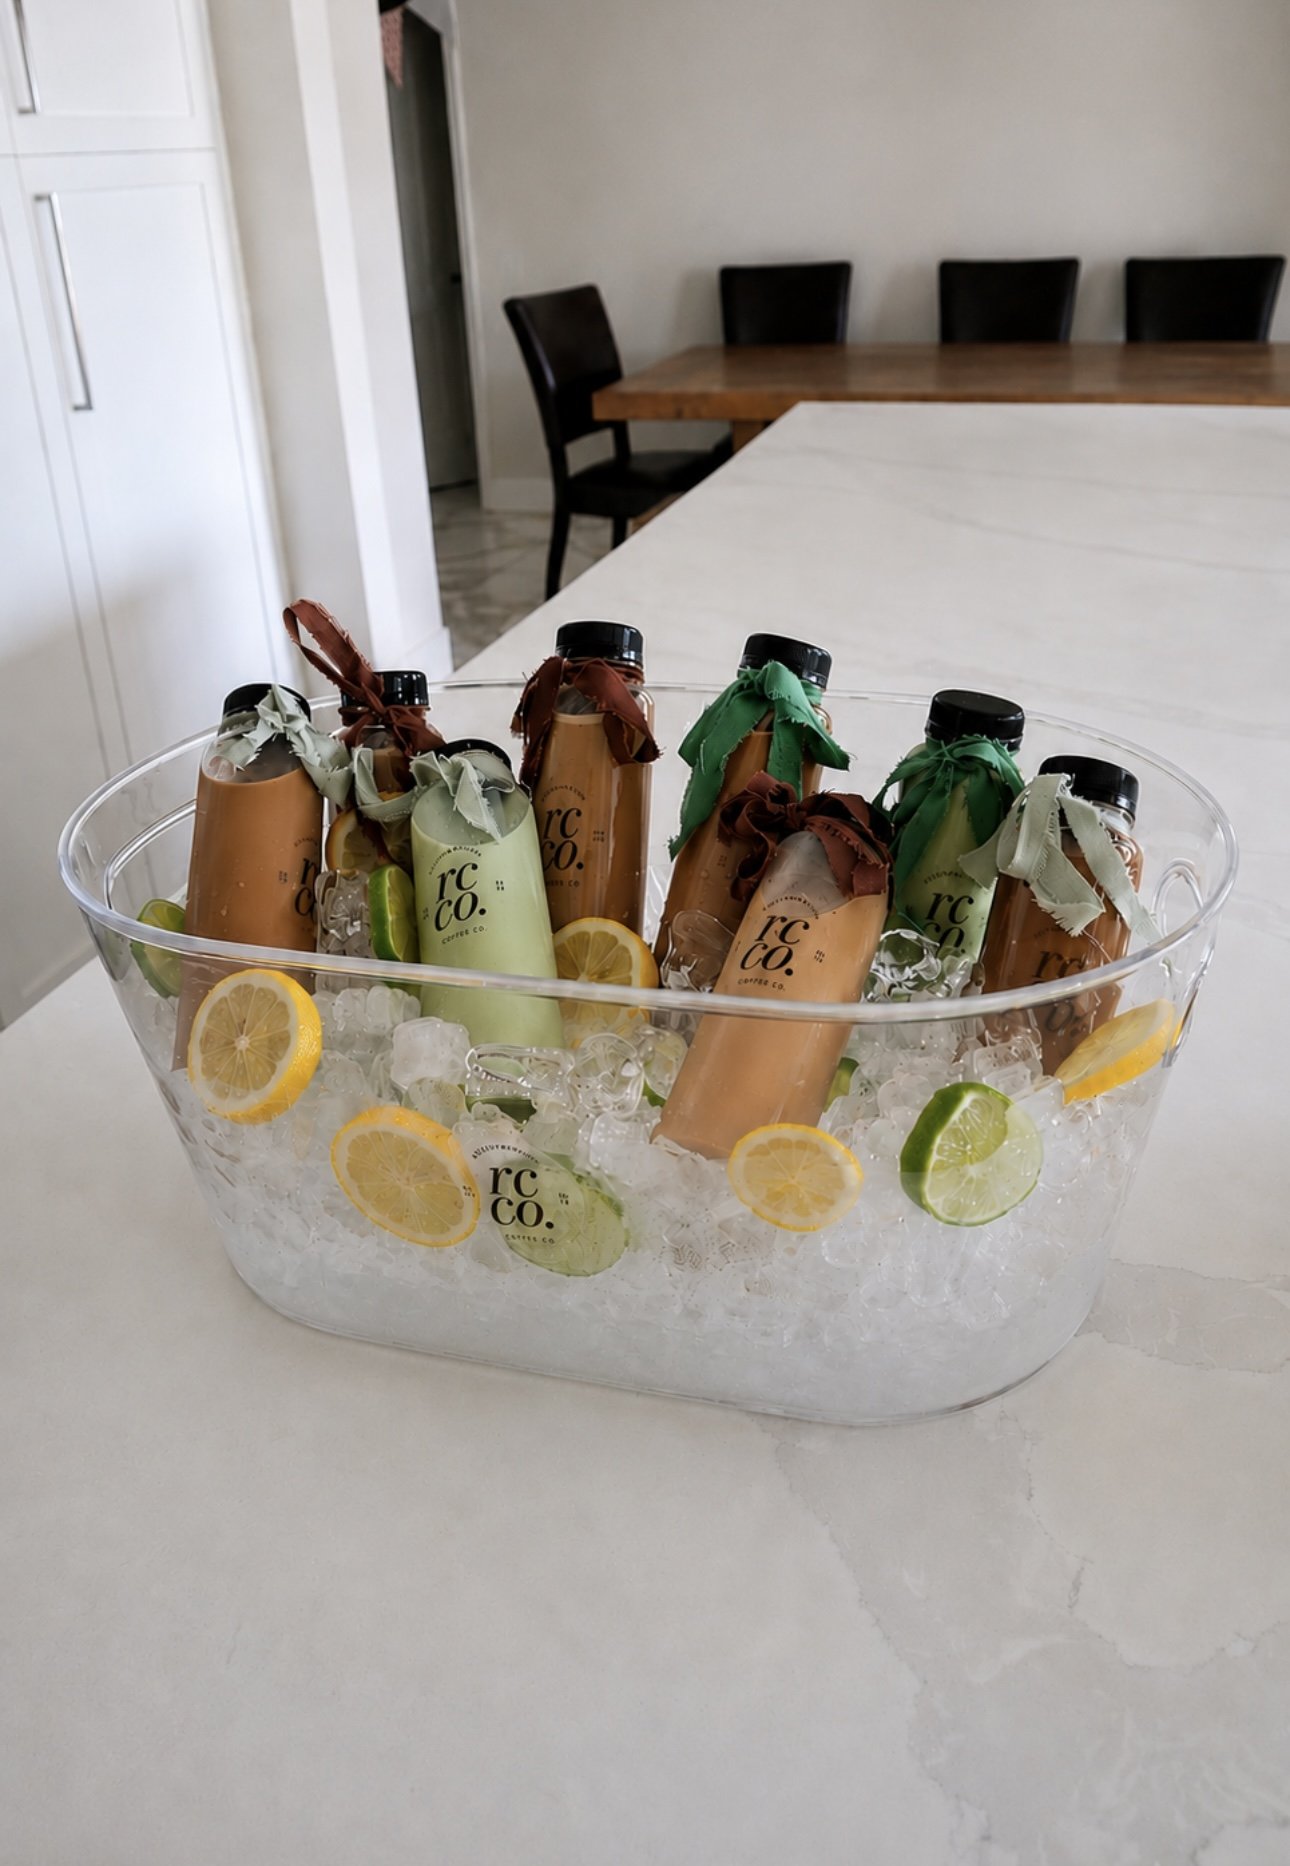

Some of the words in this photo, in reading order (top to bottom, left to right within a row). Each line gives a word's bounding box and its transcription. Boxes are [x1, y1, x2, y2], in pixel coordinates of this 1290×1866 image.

[543, 807, 582, 840] rc
[436, 862, 478, 905] rc
[434, 891, 487, 932] co.
[925, 892, 974, 925] rc
[754, 915, 810, 945] rc
[741, 942, 794, 976] co.
[489, 1167, 538, 1198] rc
[490, 1196, 554, 1230] co.
